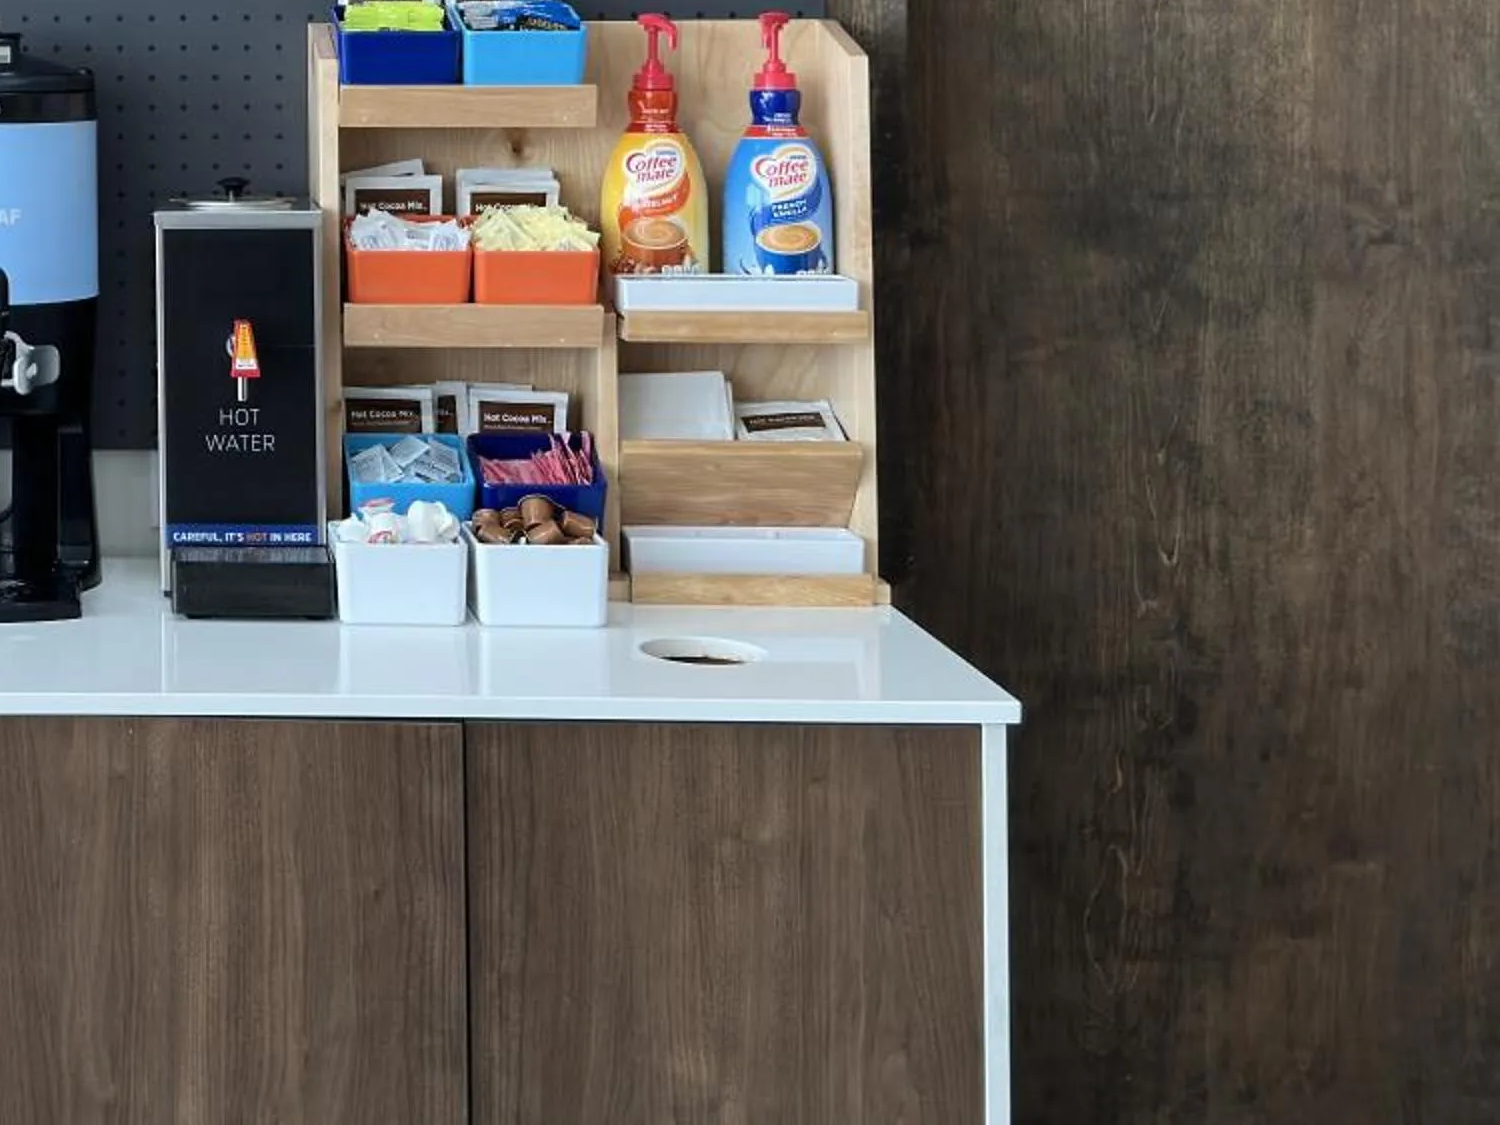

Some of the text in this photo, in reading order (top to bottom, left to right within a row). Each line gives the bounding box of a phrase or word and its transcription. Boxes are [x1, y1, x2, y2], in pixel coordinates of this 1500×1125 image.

[626, 152, 677, 174] Coffee
[755, 156, 809, 177] Coffee
[768, 172, 807, 187] mate
[219, 408, 260, 426] HOT
[205, 434, 275, 452] WATER
[173, 532, 222, 543] CAREFUL,
[269, 532, 282, 542] IN
[283, 532, 312, 542] HERE
